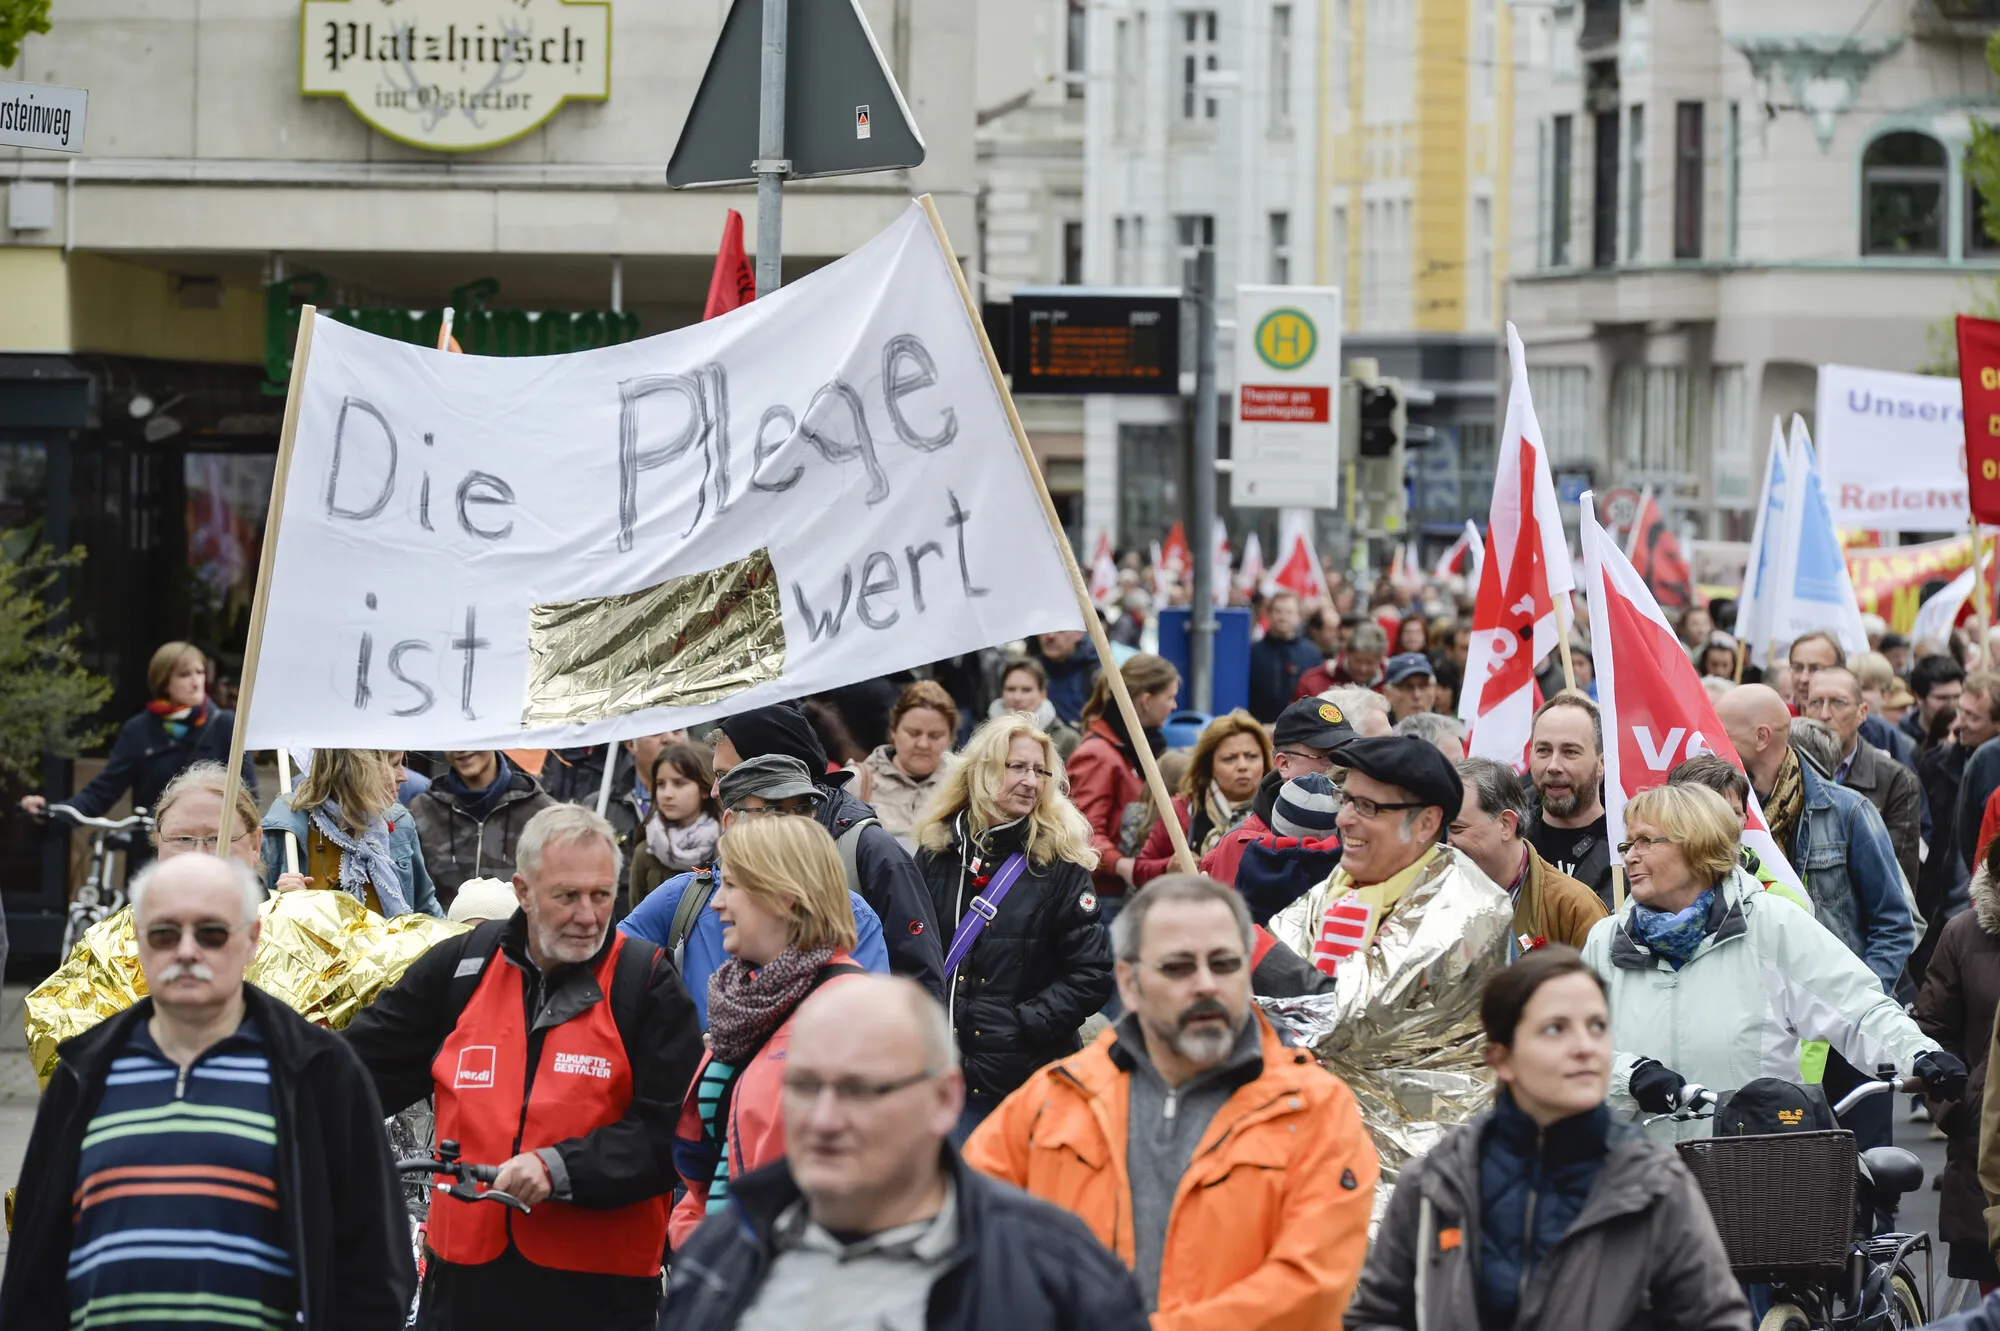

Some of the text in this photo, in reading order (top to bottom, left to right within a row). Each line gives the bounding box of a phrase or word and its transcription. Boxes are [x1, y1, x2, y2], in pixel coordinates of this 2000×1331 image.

[325, 20, 586, 74] Platzhirsch
[374, 84, 408, 109] im
[0, 94, 71, 146] rsteinweg
[326, 396, 516, 540] Die
[617, 332, 959, 553] Pflege
[354, 488, 990, 721] ist wert
[459, 1069, 490, 1082] ver.di
[553, 1062, 611, 1079] GESTALTER
[555, 1052, 612, 1068] ZUKUNFTS-
